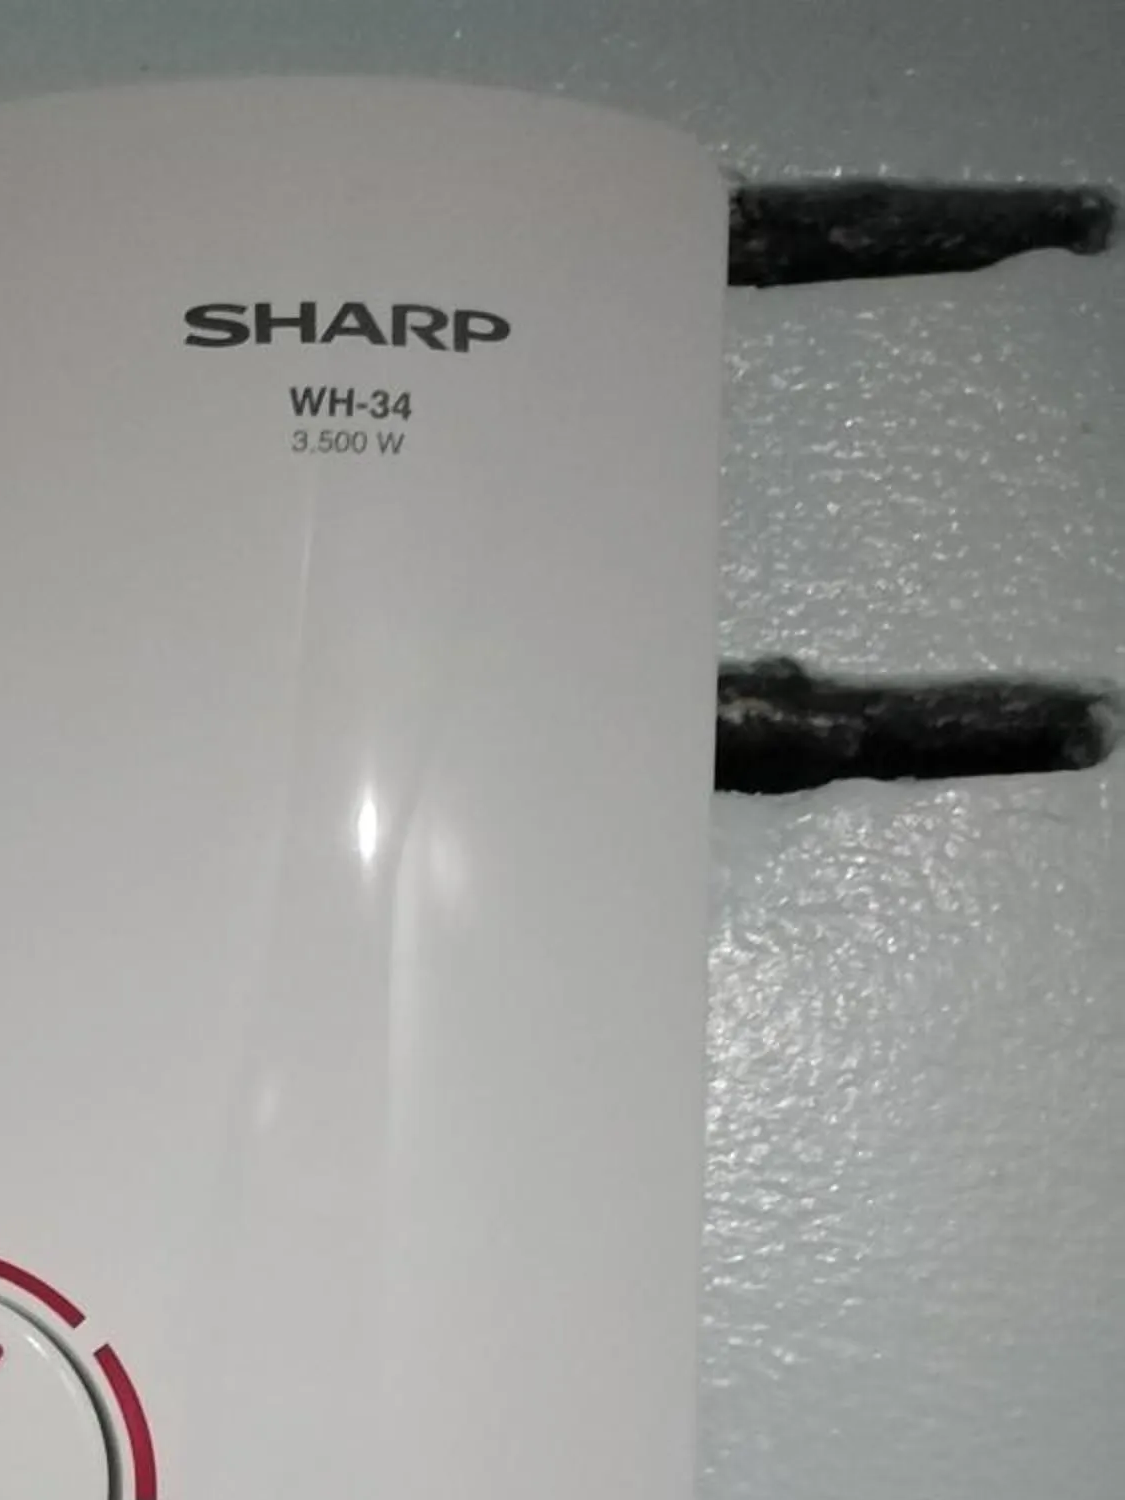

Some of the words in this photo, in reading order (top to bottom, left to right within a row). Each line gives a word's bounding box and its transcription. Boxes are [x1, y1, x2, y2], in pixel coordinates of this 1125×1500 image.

[184, 302, 510, 352] SHARP
[289, 386, 412, 421] WH-34
[377, 431, 406, 454] W
